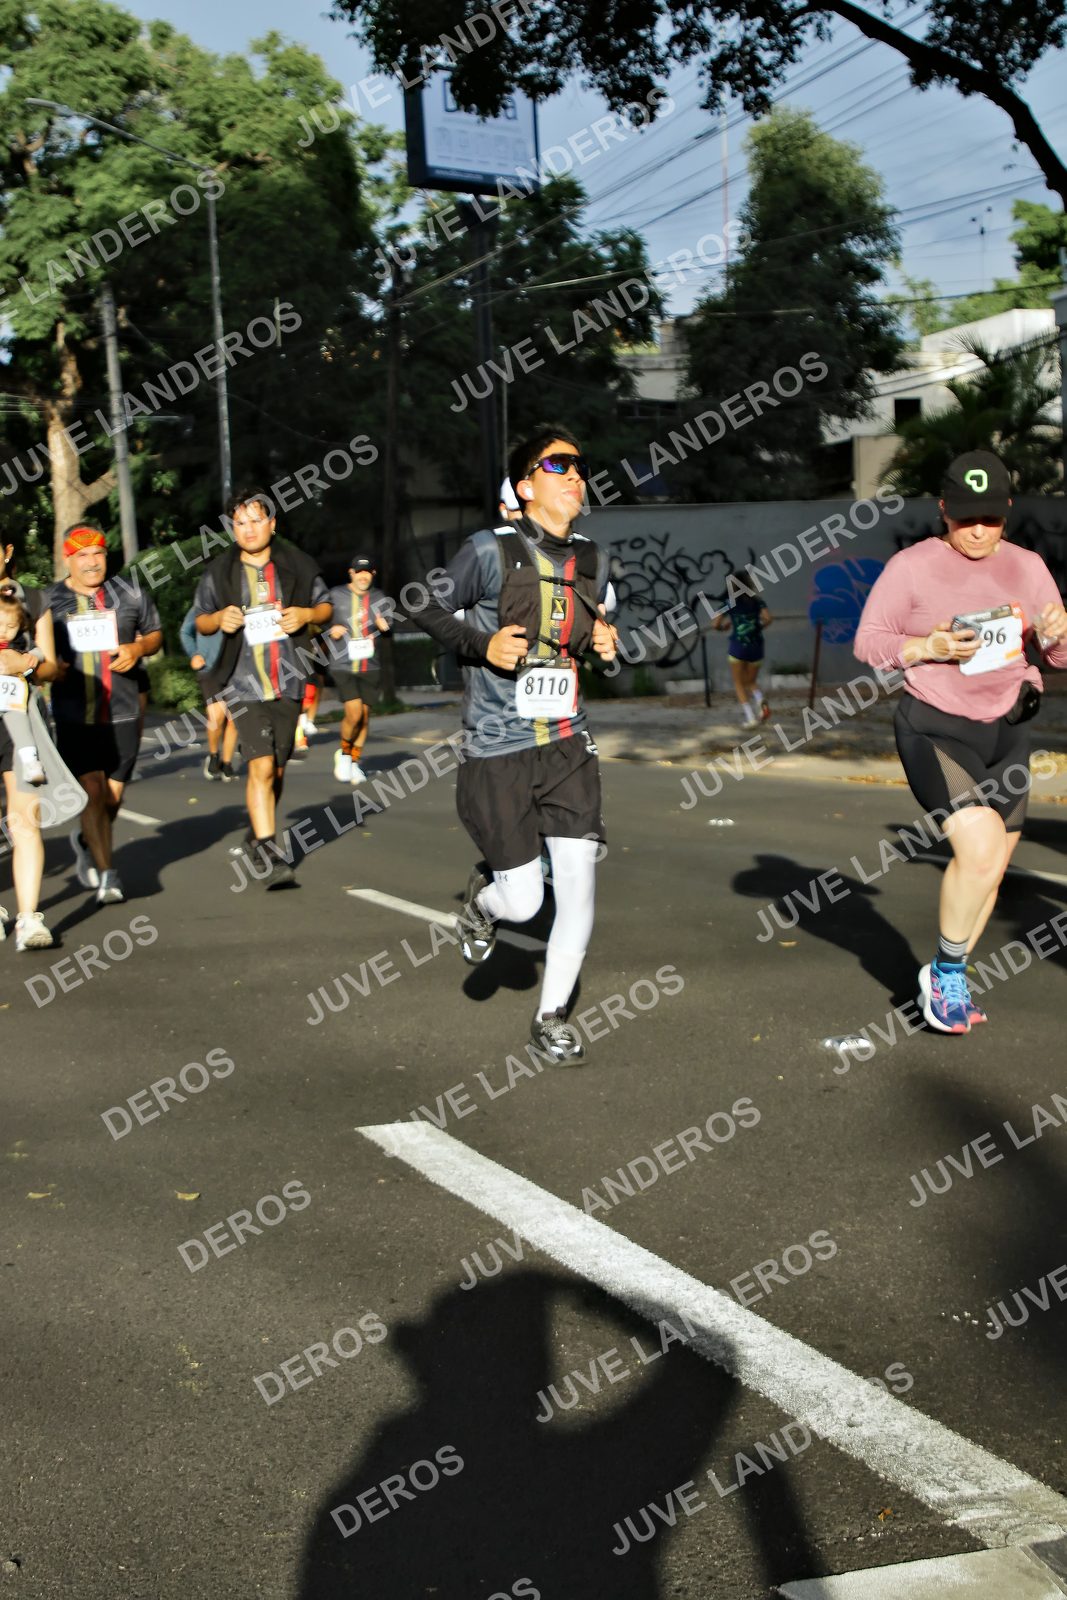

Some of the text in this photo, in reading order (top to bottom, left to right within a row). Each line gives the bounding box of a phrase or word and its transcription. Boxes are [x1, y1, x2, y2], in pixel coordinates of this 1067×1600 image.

[609, 532, 670, 554] TOY
[983, 627, 1007, 647] 96
[1, 681, 17, 696] 92
[524, 676, 569, 696] 8110
